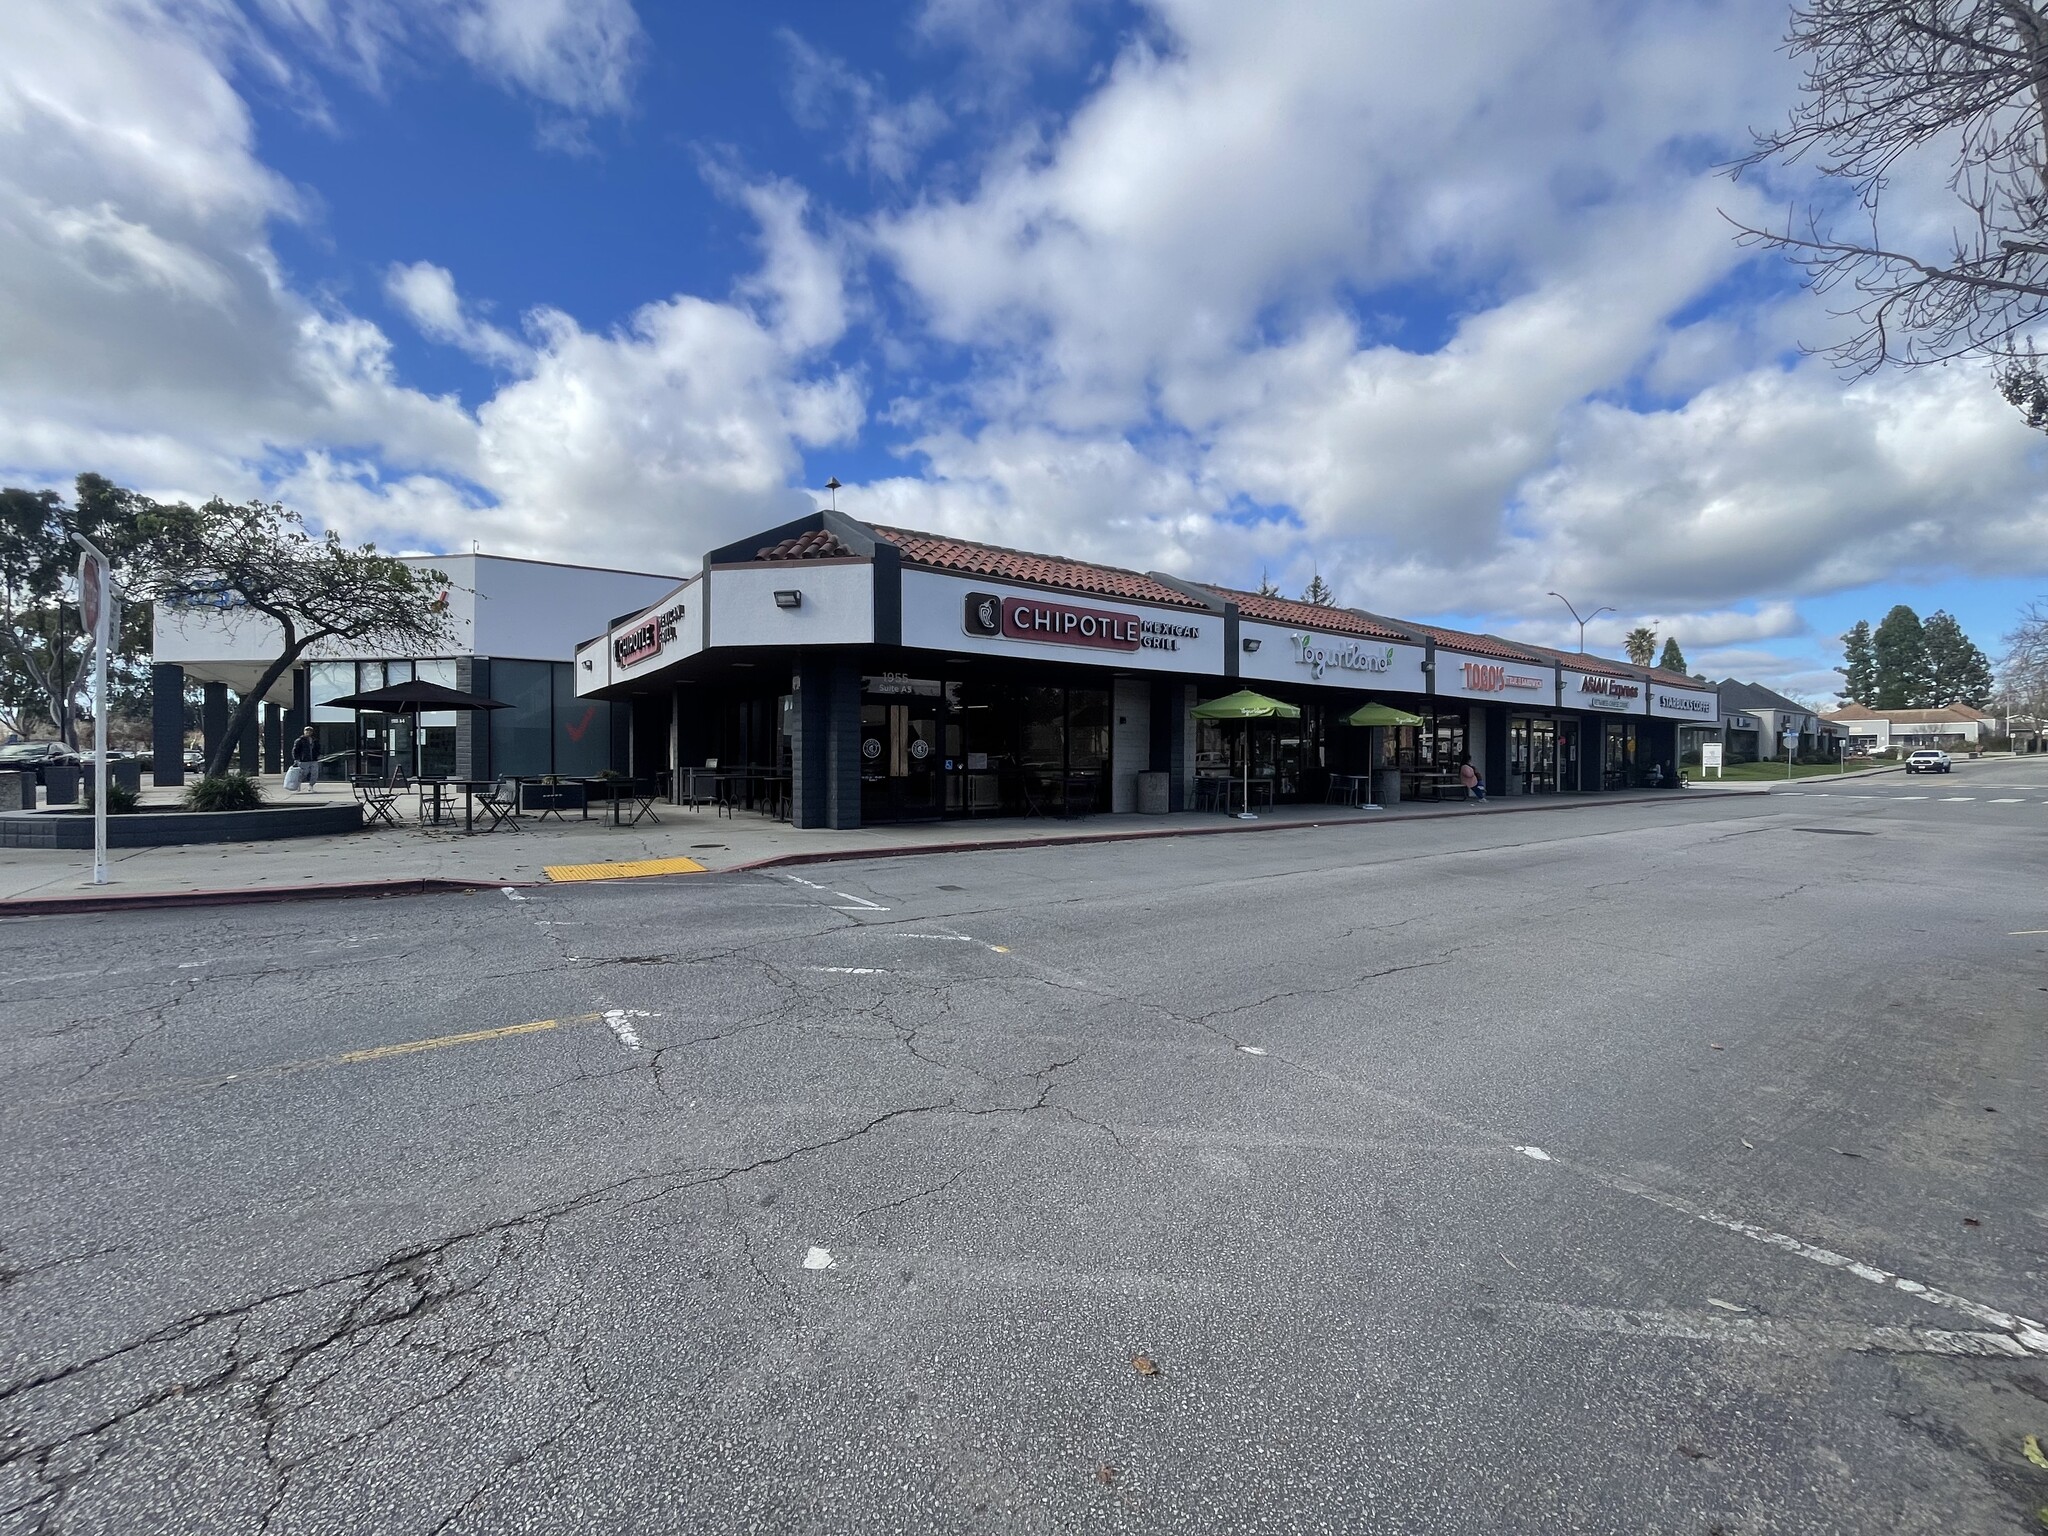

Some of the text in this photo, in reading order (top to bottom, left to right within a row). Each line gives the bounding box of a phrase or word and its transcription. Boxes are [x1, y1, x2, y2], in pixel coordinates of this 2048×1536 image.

[1014, 606, 1138, 642] CHIPOTLE
[1141, 620, 1200, 638] MEXICAN
[619, 624, 655, 658] CHIPOTLE
[1141, 635, 1180, 651] GRILL
[1290, 633, 1388, 680] Yogurtland
[882, 672, 909, 683] 1955
[1464, 662, 1505, 692] TOGO'S
[1581, 676, 1608, 694] ASIAN
[879, 684, 899, 693] Suite
[1610, 680, 1639, 699] Express
[1660, 696, 1693, 711] STARBUCKS
